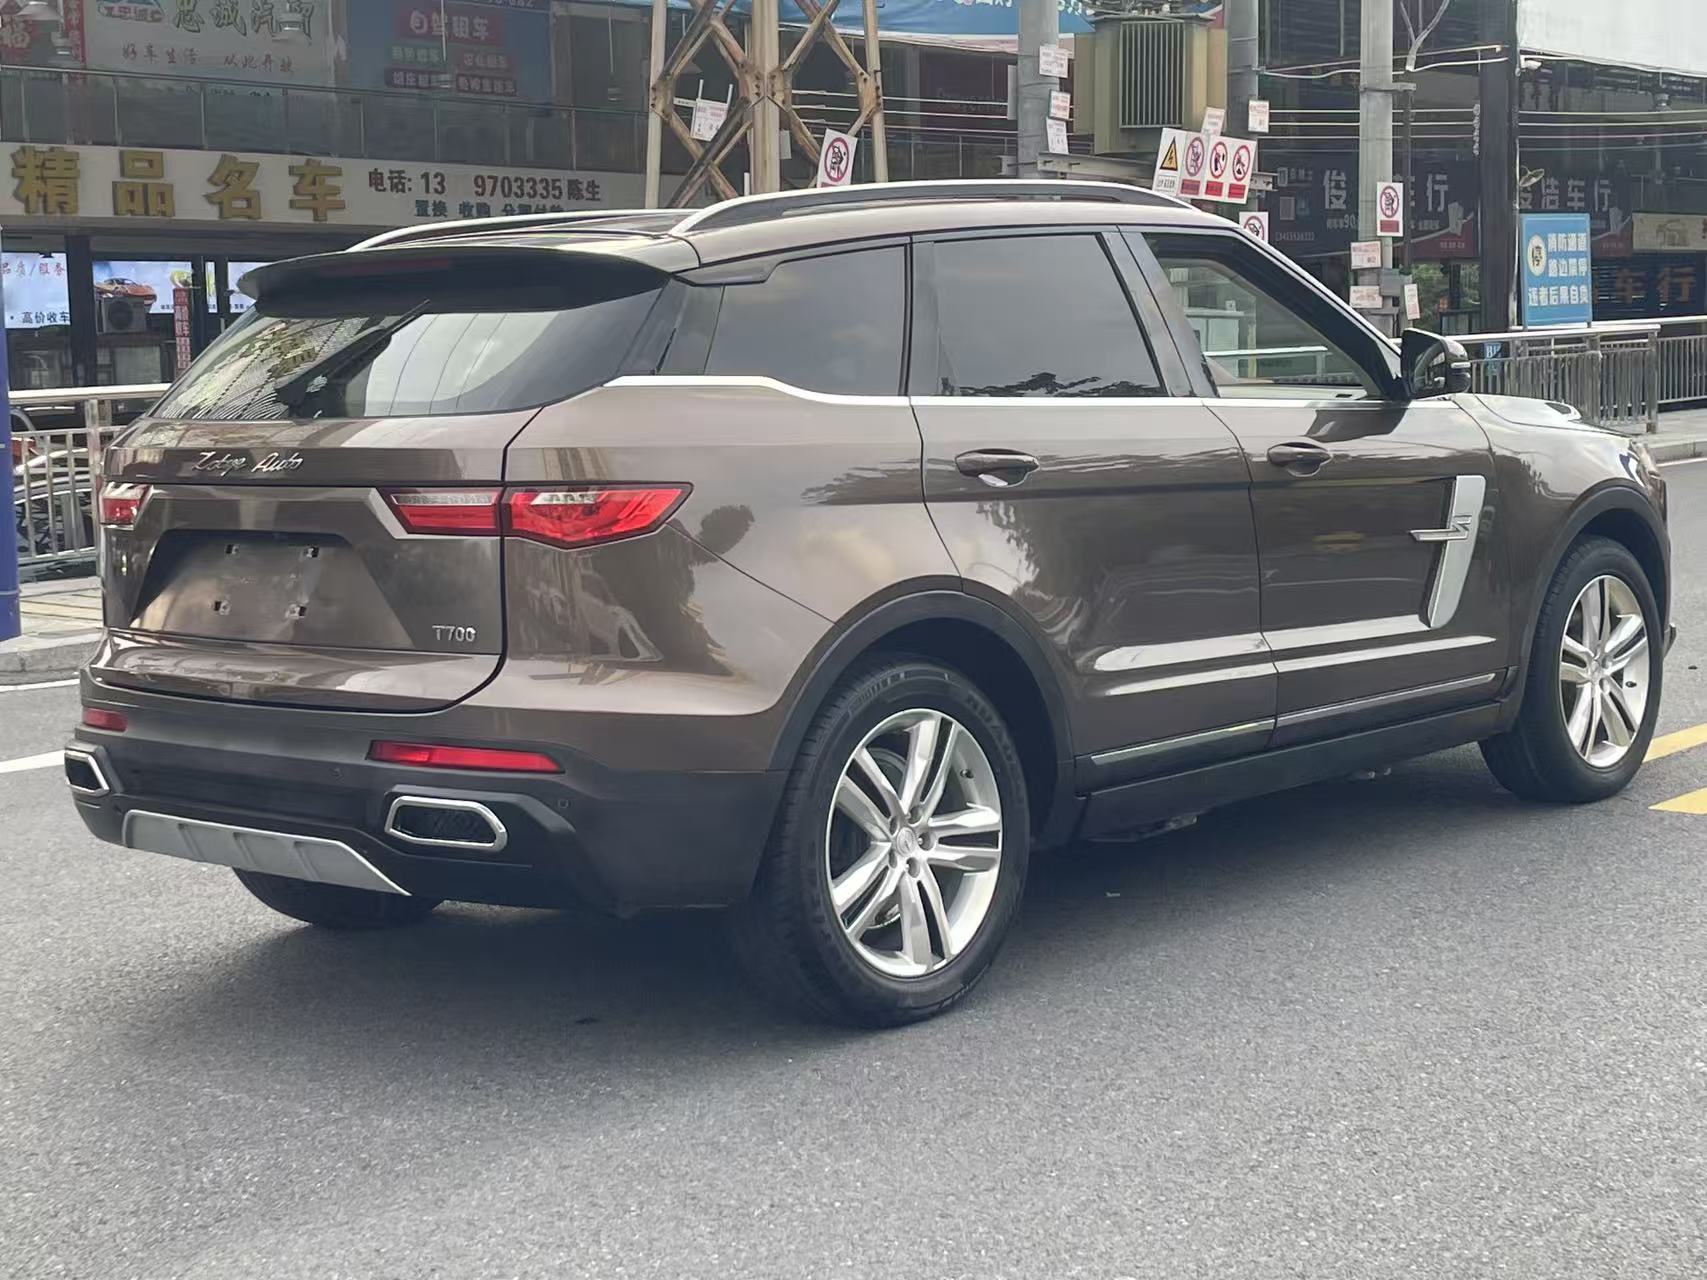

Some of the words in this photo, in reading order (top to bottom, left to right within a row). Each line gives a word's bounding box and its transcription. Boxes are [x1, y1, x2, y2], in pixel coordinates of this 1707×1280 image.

[11, 146, 346, 221] 精品名车
[368, 168, 412, 194] 电话:
[421, 171, 446, 196] 13
[473, 175, 563, 200] 9703335
[22, 311, 70, 324] 高价收车
[251, 452, 304, 473] Auto
[431, 624, 477, 642] T700
